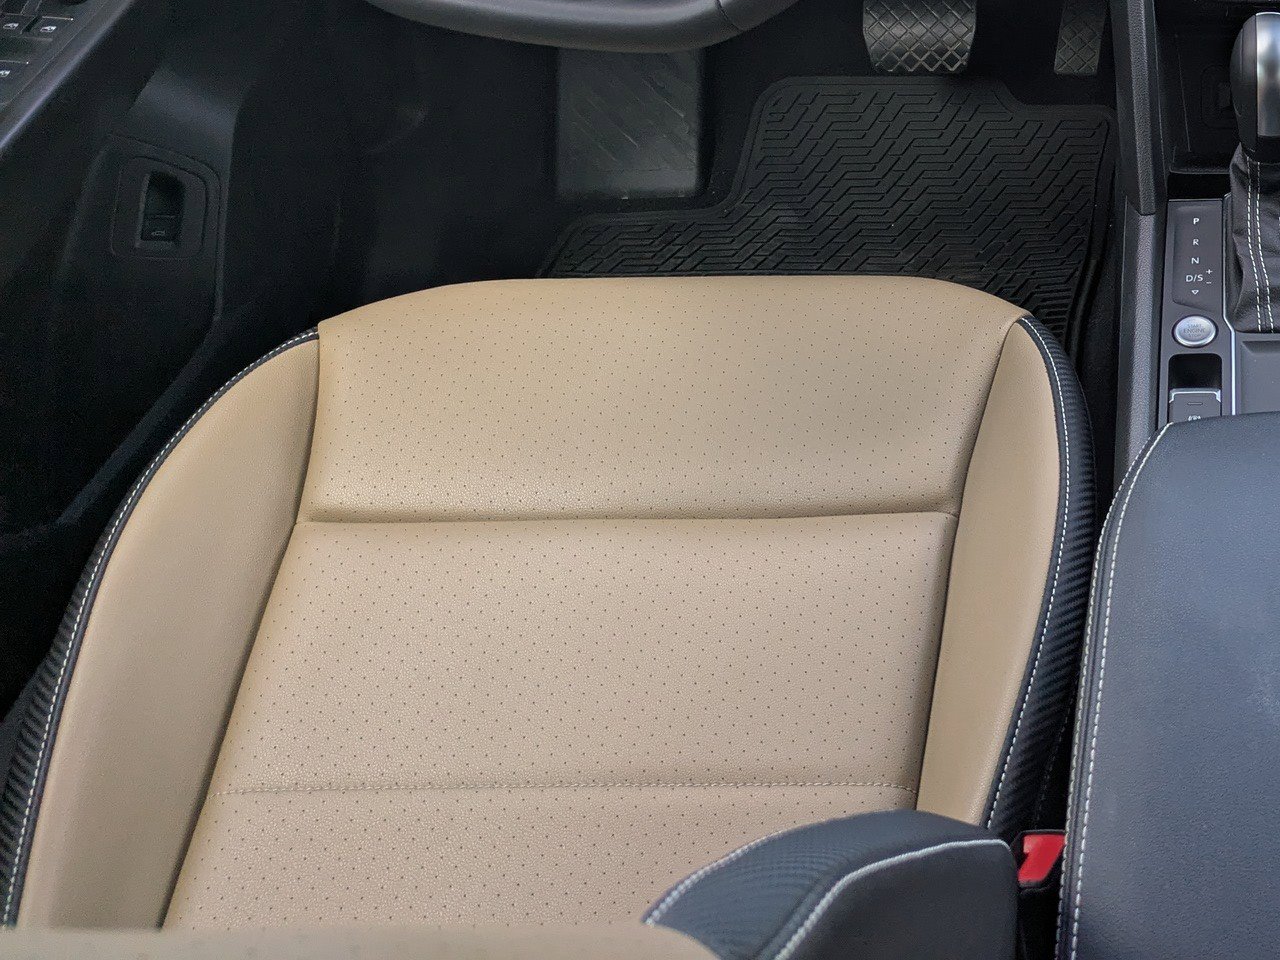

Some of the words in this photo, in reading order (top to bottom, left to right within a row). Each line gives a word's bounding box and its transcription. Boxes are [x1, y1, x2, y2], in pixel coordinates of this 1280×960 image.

[1193, 217, 1200, 225] P
[1192, 238, 1199, 246] R
[1185, 274, 1204, 283] D/S
